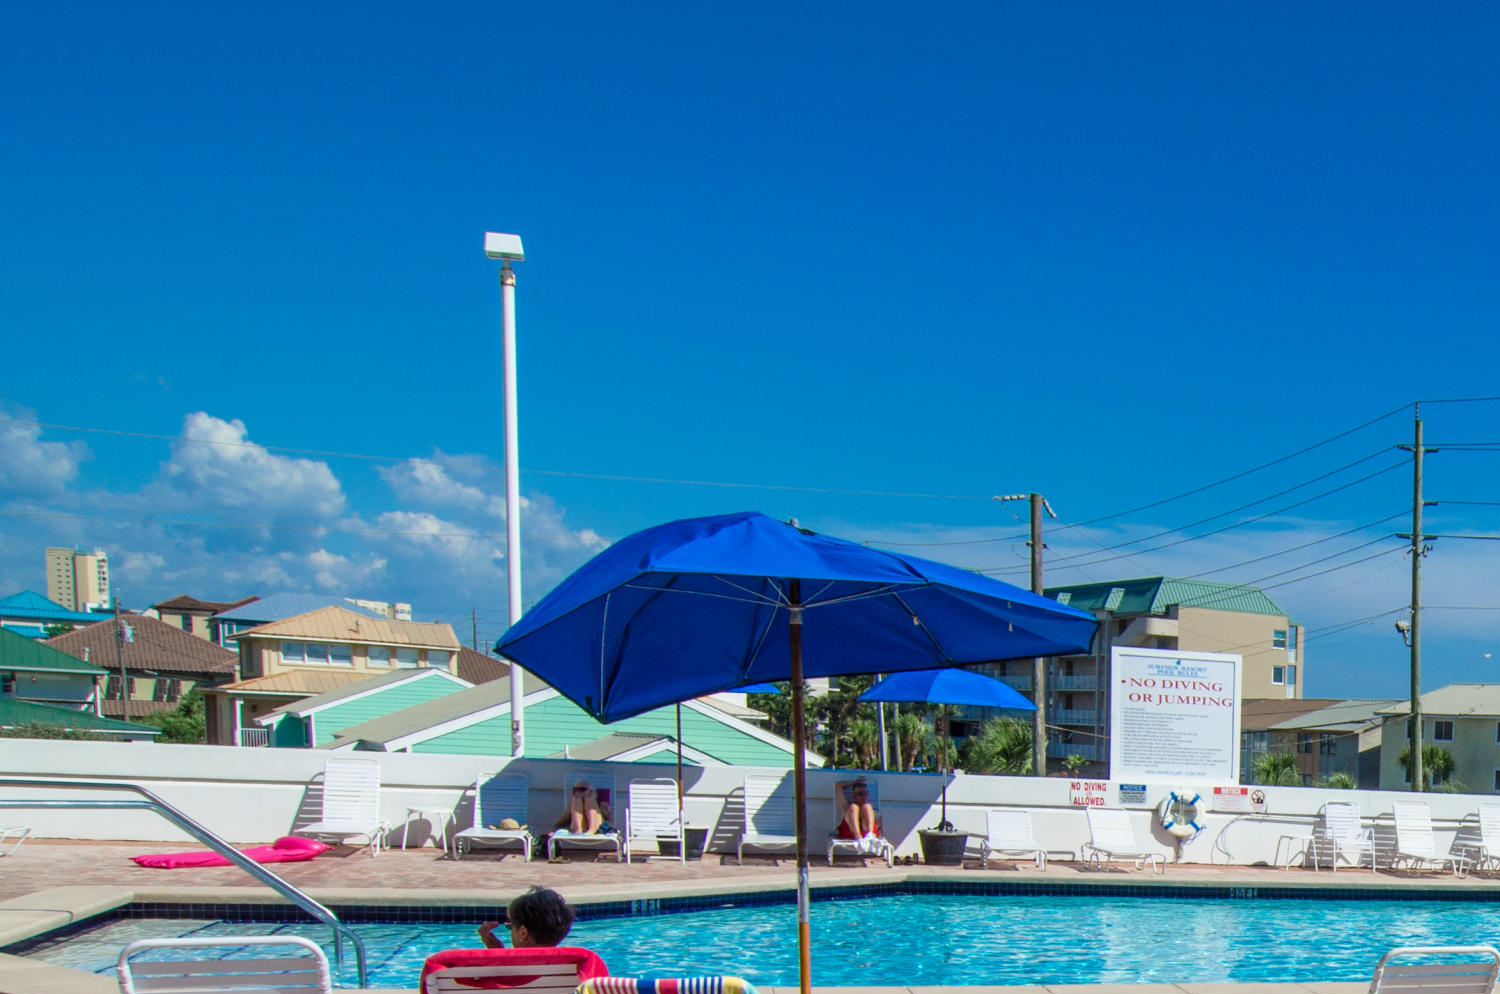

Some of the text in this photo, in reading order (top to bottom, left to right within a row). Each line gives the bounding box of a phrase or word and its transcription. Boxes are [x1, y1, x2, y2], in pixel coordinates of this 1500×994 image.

[1130, 678, 1223, 692] NO DIVING
[1128, 692, 1232, 707] OR JUMPING
[1071, 782, 1107, 791] NO DIVING
[1073, 797, 1105, 806] ALLOWED
